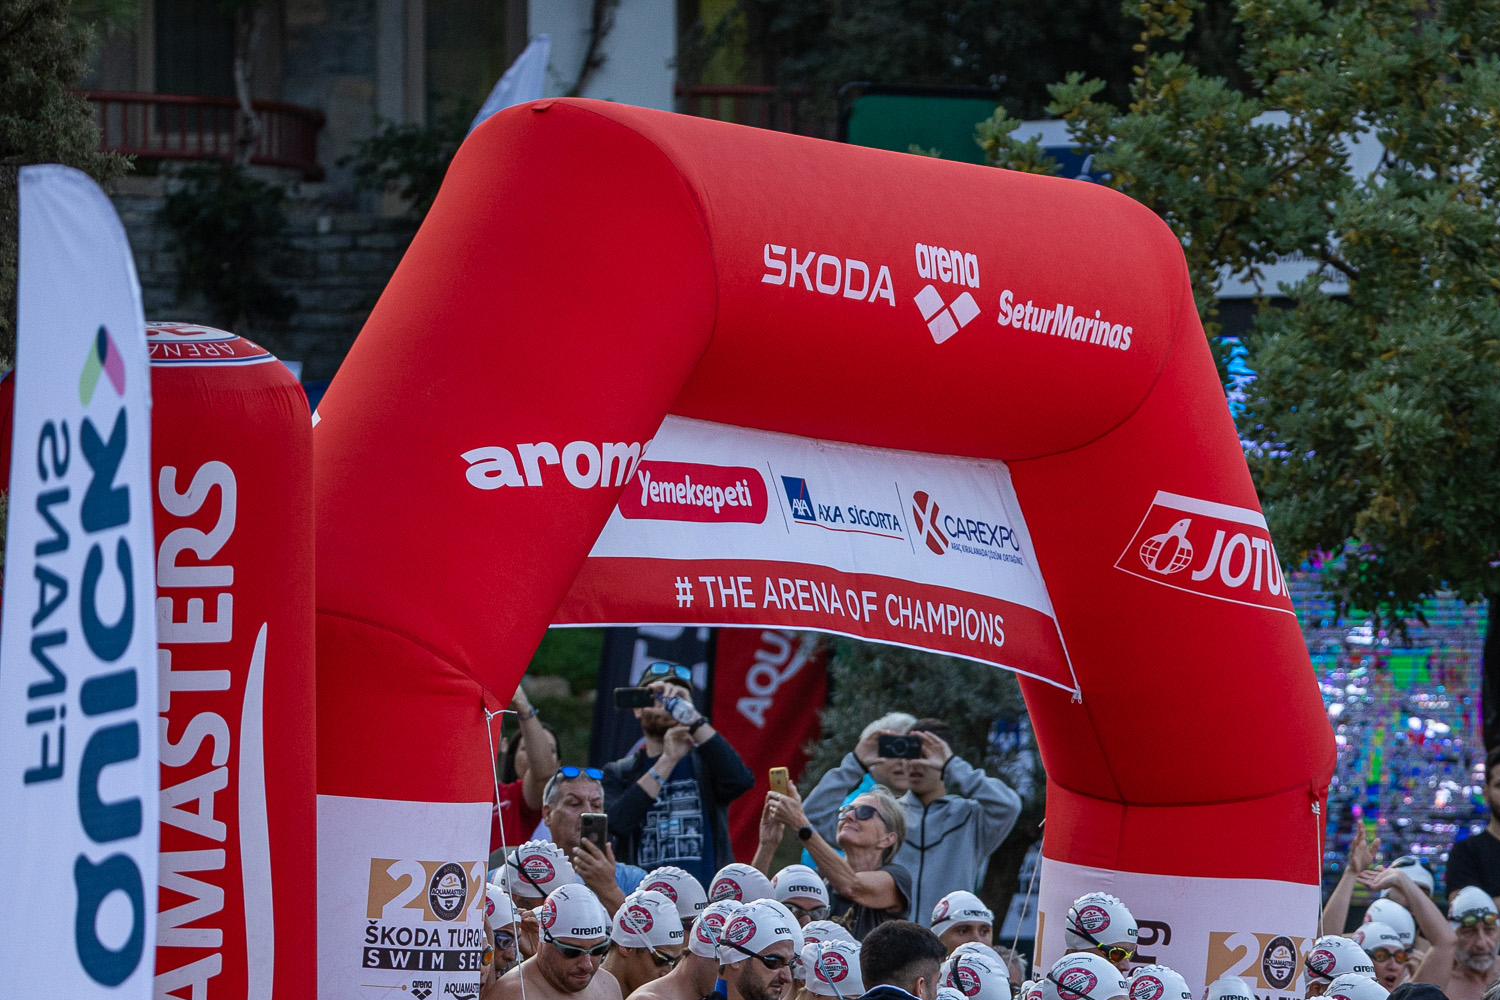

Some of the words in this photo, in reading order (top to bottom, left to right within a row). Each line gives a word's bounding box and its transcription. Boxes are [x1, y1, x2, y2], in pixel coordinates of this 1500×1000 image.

[915, 242, 980, 288] arena
[997, 289, 1133, 351] SeturMarinas
[460, 439, 653, 490] arom
[638, 470, 752, 514] Yemeksepeti
[791, 498, 812, 517] AXA
[818, 504, 845, 524] AXA
[944, 515, 1020, 552] CAREXPO
[675, 576, 694, 608] #
[699, 576, 756, 608] THE
[763, 577, 845, 617] ARENA
[846, 589, 877, 622] OF
[885, 593, 1005, 647] CHAMPIONS
[788, 885, 822, 896] arena
[364, 920, 441, 948] ŠKODA
[448, 928, 482, 948] TURQ
[571, 926, 602, 936] arena
[669, 930, 684, 938] are
[775, 927, 791, 935] are
[367, 950, 444, 970] SWIM
[412, 980, 432, 989] arena
[1181, 992, 1193, 1000] are
